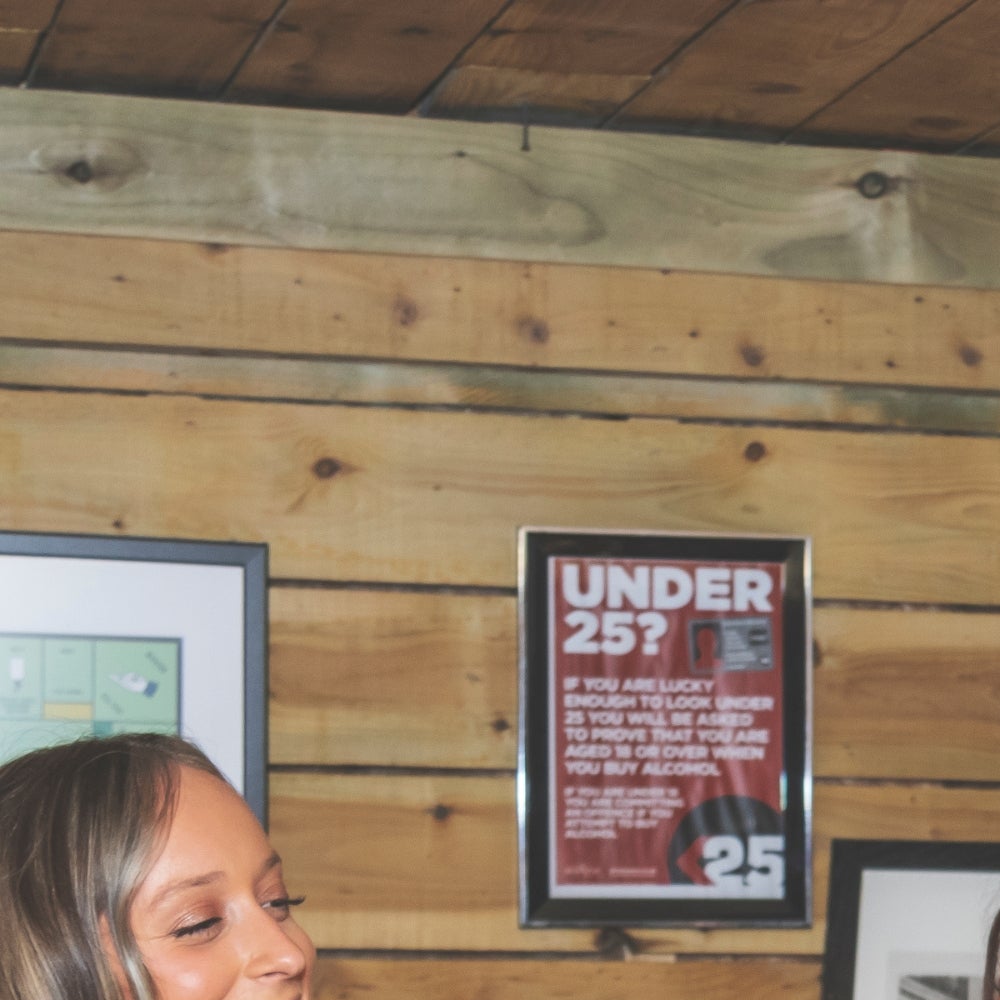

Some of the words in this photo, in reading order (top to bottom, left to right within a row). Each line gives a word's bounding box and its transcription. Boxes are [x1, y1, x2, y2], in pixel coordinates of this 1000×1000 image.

[562, 564, 774, 612] UNDER
[562, 611, 668, 655] 25?
[563, 678, 579, 691] IF
[583, 678, 619, 691] YOU
[623, 679, 656, 692] ARE
[659, 679, 714, 692] LUCKY
[564, 694, 637, 708] ENOUGH
[640, 695, 663, 709] TO
[666, 696, 712, 709] LOOK
[715, 697, 774, 711] UNDER
[564, 711, 585, 725] 25
[588, 712, 624, 725] YOU
[627, 712, 667, 726] WILL
[671, 713, 693, 726] BE
[697, 713, 754, 727] ASKED
[565, 727, 588, 741] TO
[591, 728, 646, 742] PROVE
[651, 729, 692, 742] THAT
[697, 729, 732, 743] YOU
[735, 730, 770, 743] ARE
[565, 744, 611, 758] AGED
[635, 745, 659, 759] OR
[663, 746, 708, 759] OVER
[712, 746, 766, 760] WHEN
[565, 761, 600, 775] YOU
[603, 761, 640, 775] BUY
[701, 836, 784, 890] 25
